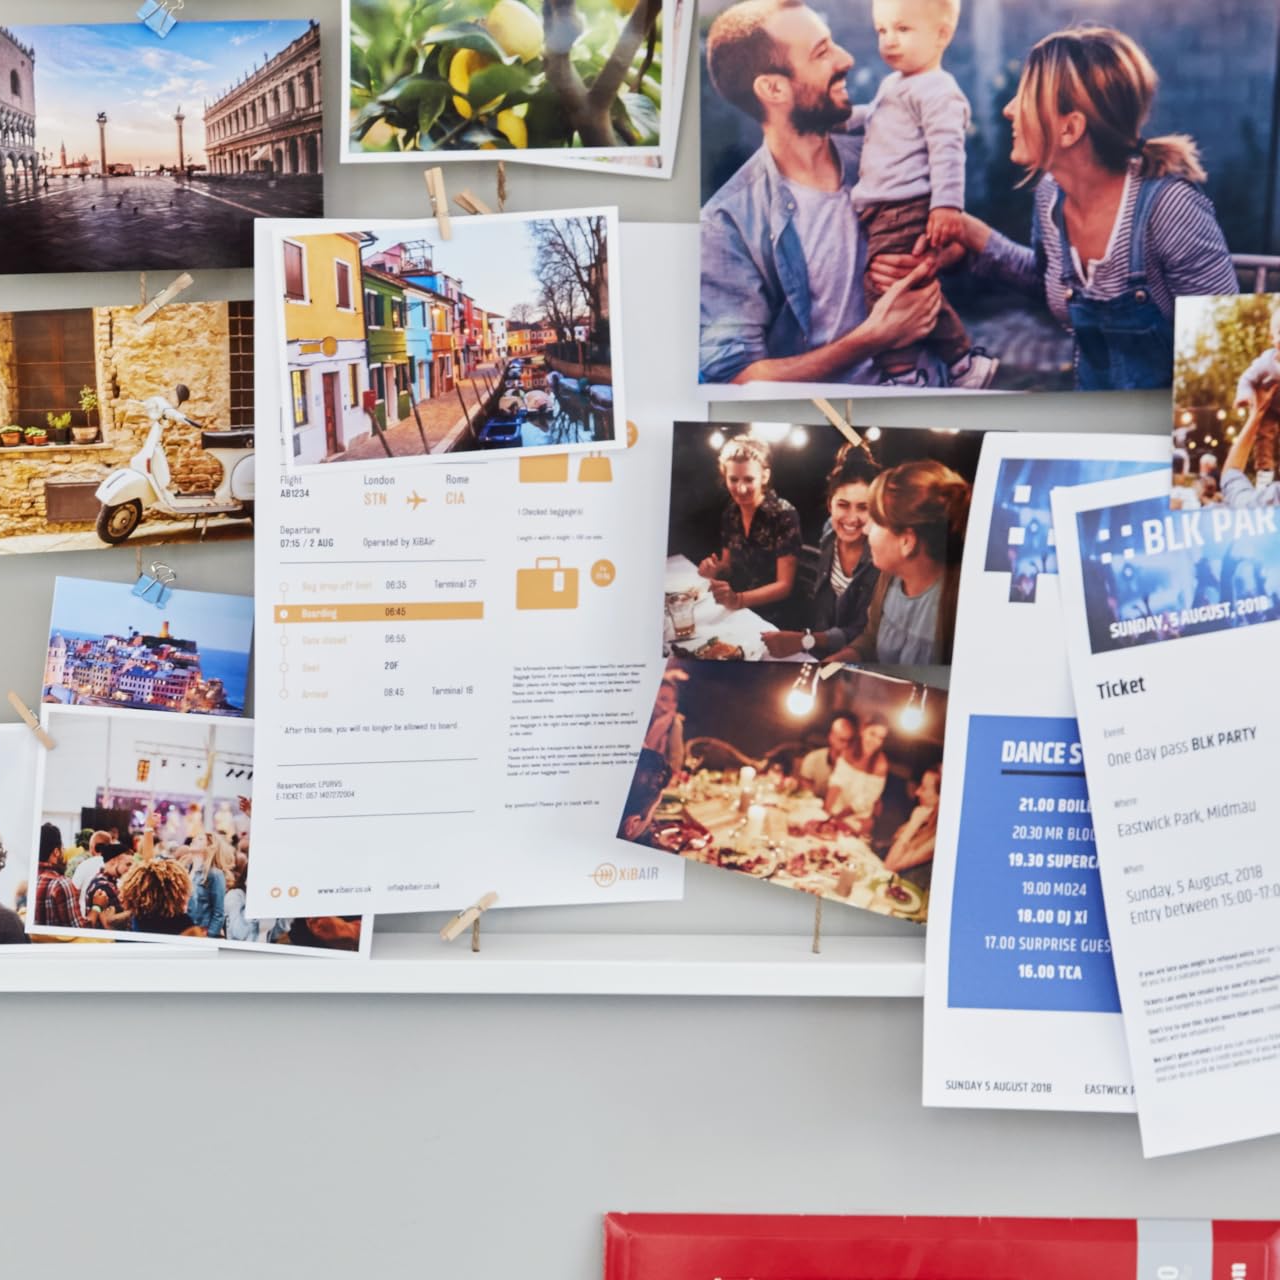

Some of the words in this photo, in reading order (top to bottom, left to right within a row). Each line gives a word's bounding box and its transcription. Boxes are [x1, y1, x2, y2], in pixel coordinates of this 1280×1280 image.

[363, 475, 395, 485] London
[445, 474, 469, 484] Rome
[280, 489, 310, 498] AB1234
[363, 493, 387, 505] STN
[445, 491, 465, 505] CIA
[280, 526, 321, 536] Departure
[1142, 511, 1204, 556] BLK
[280, 538, 300, 548] 07:15
[318, 538, 334, 548] AUG
[434, 579, 467, 589] Terminal
[431, 686, 464, 696] Terminal
[1096, 677, 1147, 700] Ticket
[1001, 740, 1067, 764] DANCE
[1107, 752, 1132, 767] One
[1135, 745, 1157, 762] day
[1161, 740, 1189, 759] pass
[1191, 735, 1215, 752] BLK
[1217, 726, 1257, 746] PARTY
[1018, 797, 1055, 812] 21.00
[1117, 814, 1172, 838] Eastwick
[1174, 808, 1205, 827] Park,
[1012, 825, 1043, 840] 20.30
[1044, 826, 1063, 841] MR
[1008, 852, 1045, 868] 19.30
[1022, 881, 1052, 895] 19.00
[1126, 883, 1175, 903] Sunday,
[1177, 881, 1185, 894] 5
[1235, 864, 1263, 882] 2018
[1017, 908, 1055, 925] 18.00
[1056, 910, 1071, 927] DJ
[1130, 907, 1162, 925] Entry
[1164, 896, 1219, 918] between
[984, 935, 1016, 951] 17.00
[1018, 936, 1078, 953] SURPRISE
[1017, 964, 1055, 980] 16.00
[1057, 965, 1083, 981] TCA
[945, 1080, 983, 1092] SUNDAY
[984, 1081, 991, 1092] 5
[993, 1082, 1029, 1093] AUGUST
[1030, 1083, 1053, 1094] 2018
[1084, 1083, 1128, 1096] EASTWICK
